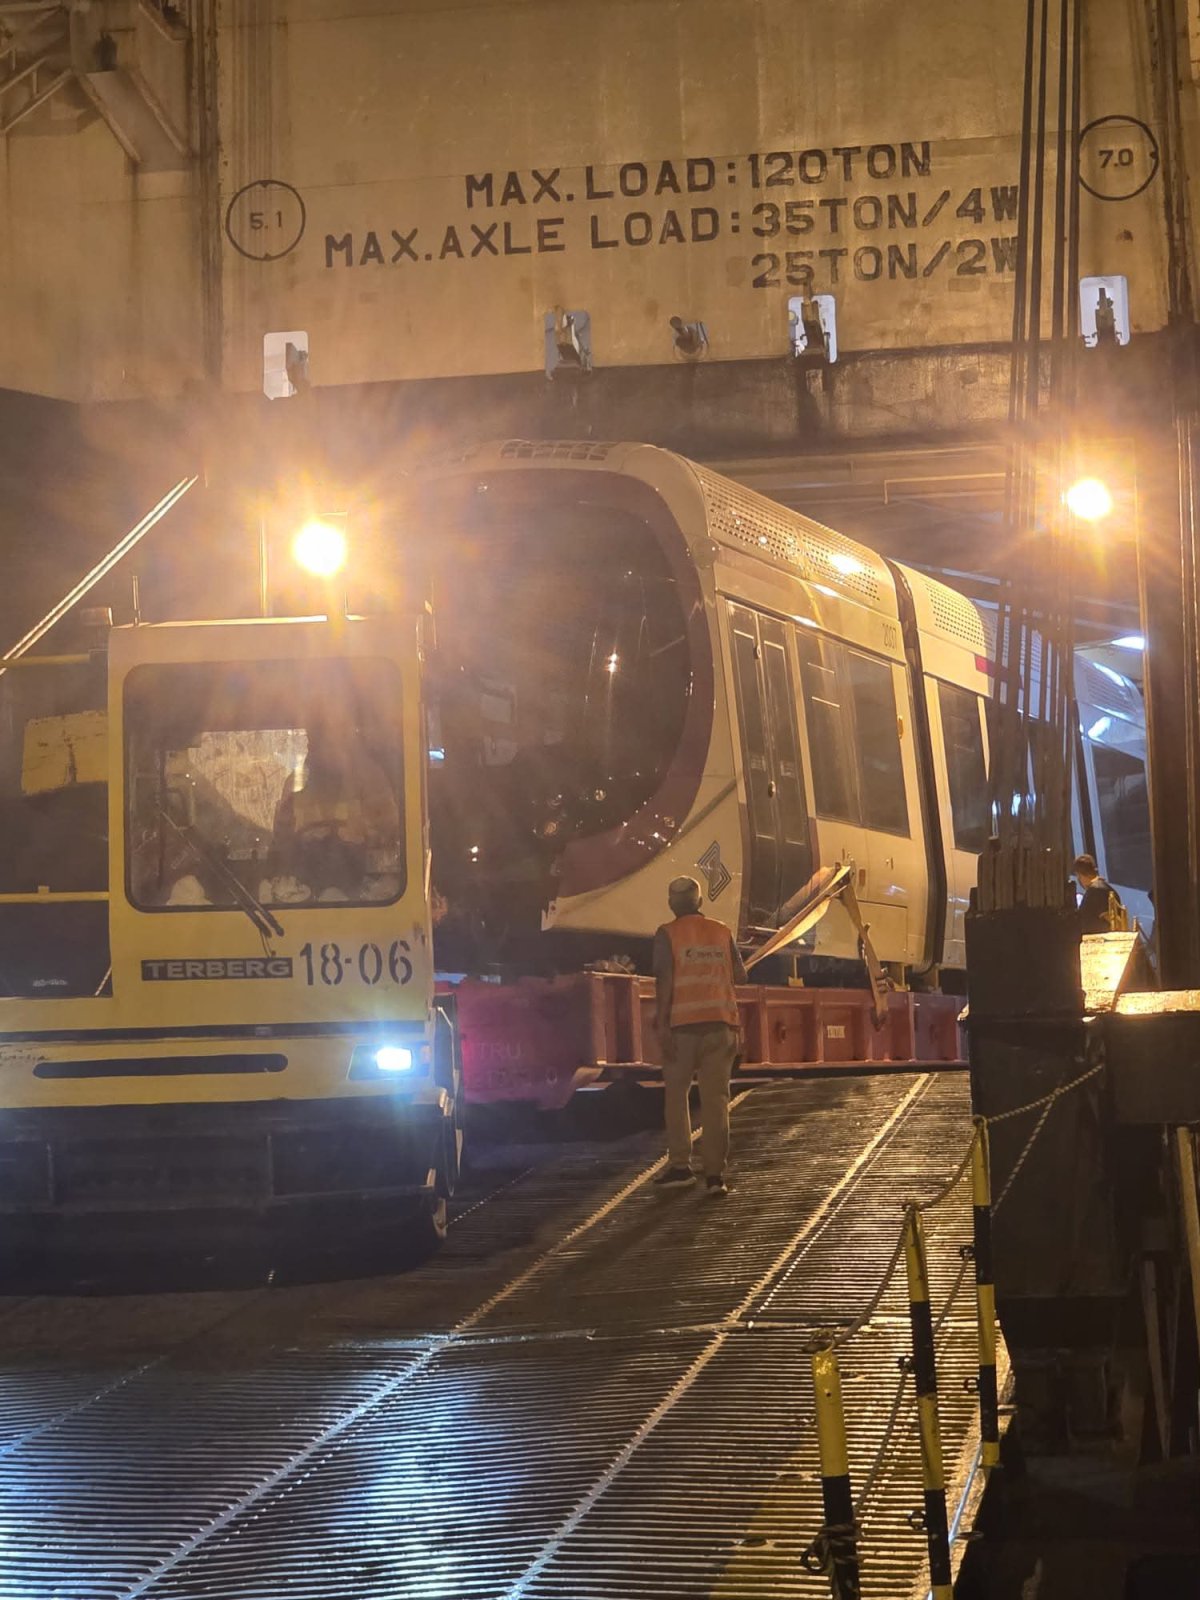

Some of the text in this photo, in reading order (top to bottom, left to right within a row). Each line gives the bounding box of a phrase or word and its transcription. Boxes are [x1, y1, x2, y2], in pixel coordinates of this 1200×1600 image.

[1098, 148, 1134, 169] 7.0
[249, 211, 284, 231] 5.1
[751, 236, 1016, 289] 25TON/2W
[144, 959, 292, 979] TERBERG
[300, 940, 413, 986] 18-06
